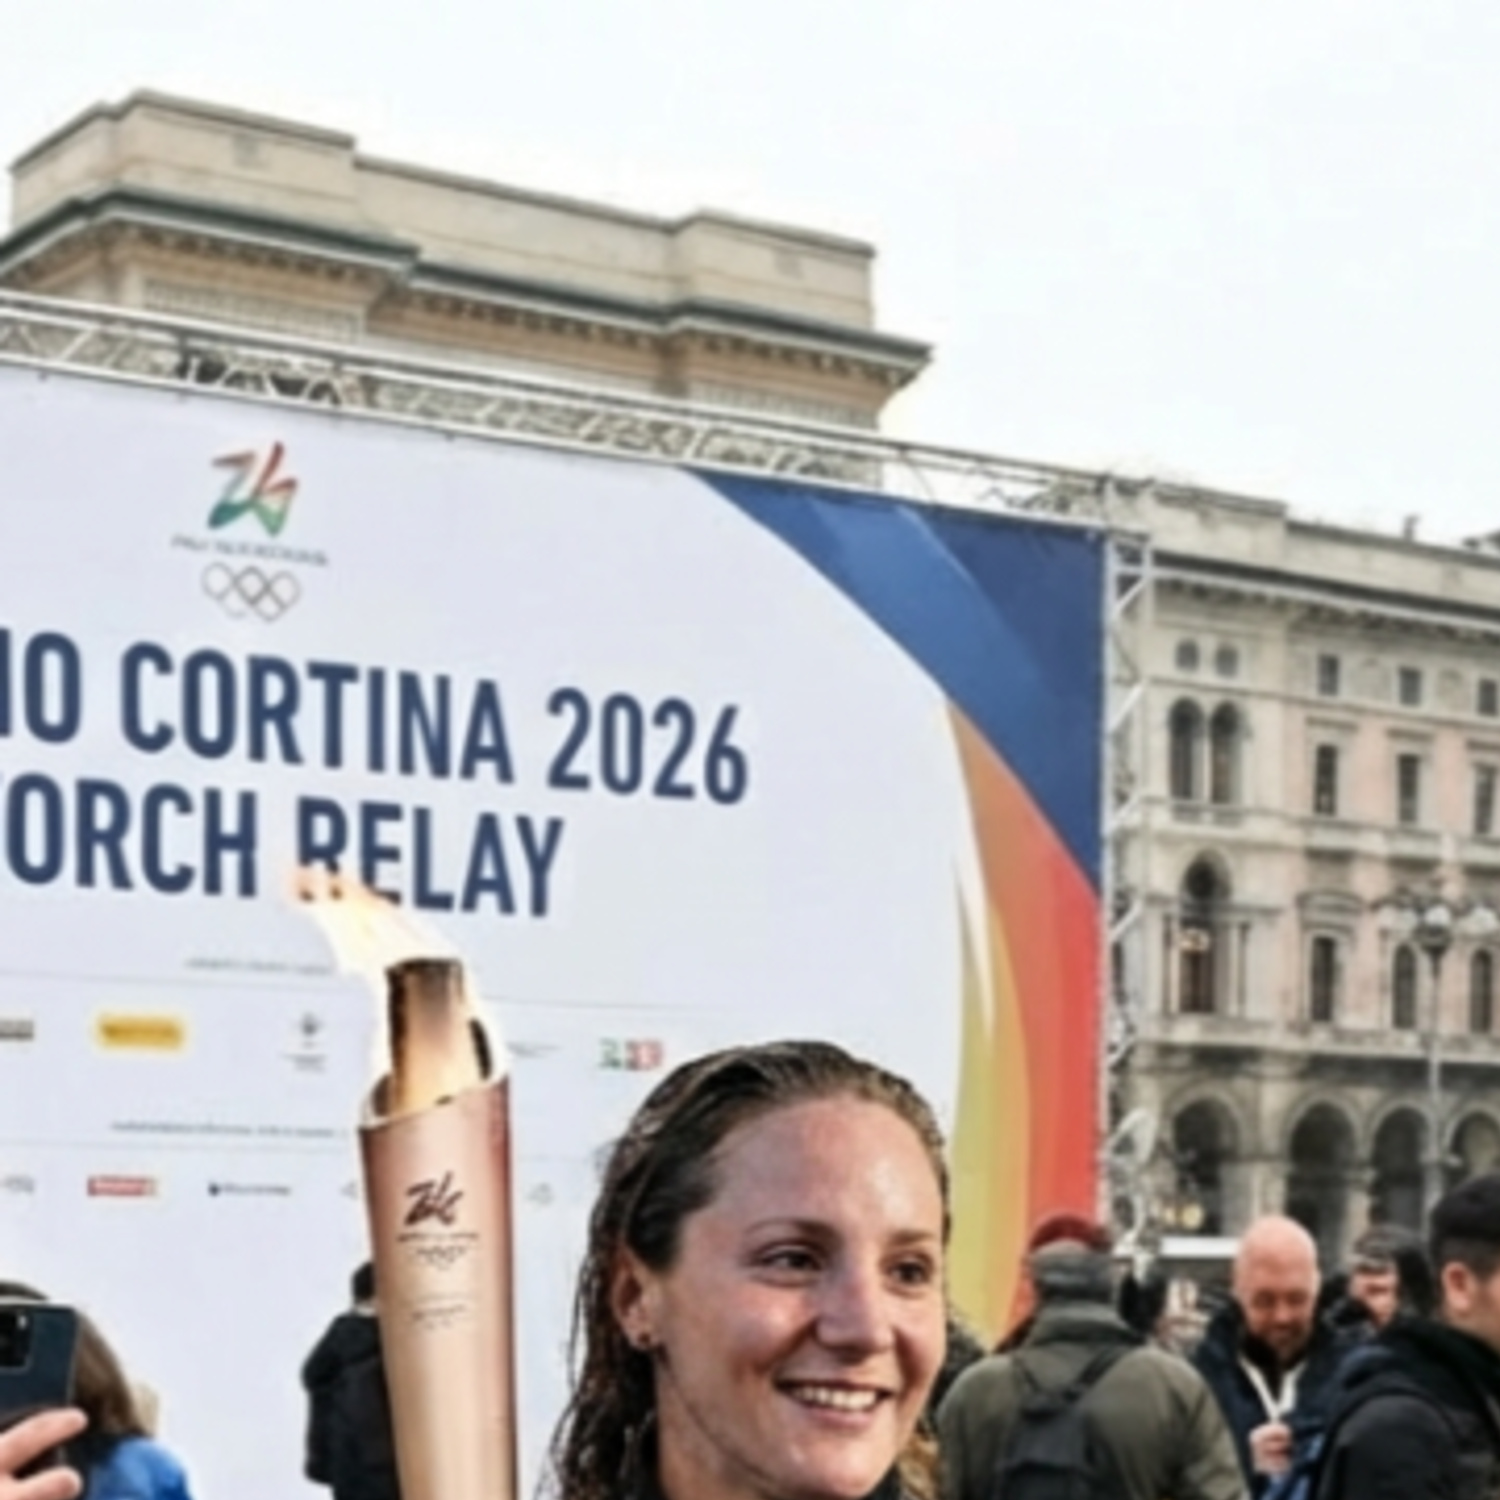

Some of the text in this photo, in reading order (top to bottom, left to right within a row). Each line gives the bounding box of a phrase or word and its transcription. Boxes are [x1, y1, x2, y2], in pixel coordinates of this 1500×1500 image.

[0, 627, 748, 805] O CORTINA 2026
[0, 772, 564, 917] ORCH RELAY
